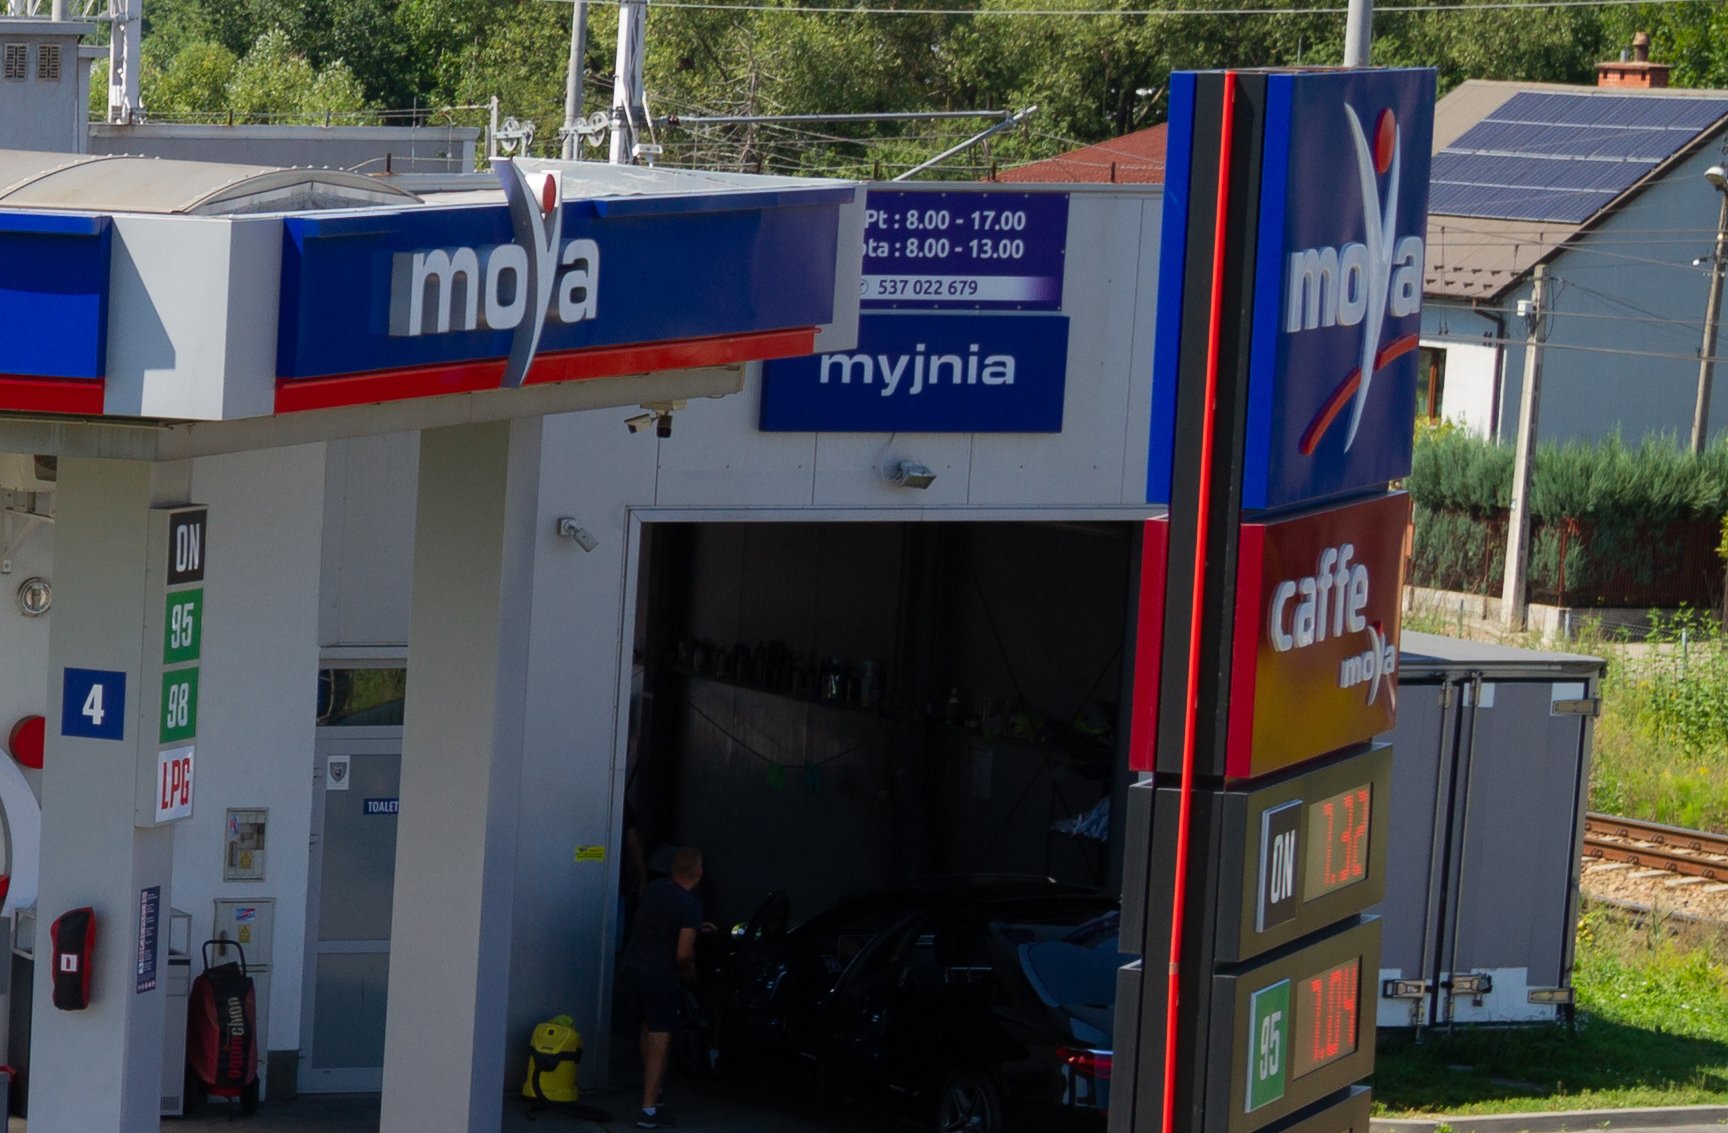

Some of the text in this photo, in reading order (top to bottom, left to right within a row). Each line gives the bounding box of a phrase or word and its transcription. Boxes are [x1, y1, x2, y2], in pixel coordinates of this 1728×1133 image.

[865, 210, 888, 229] Pt
[906, 210, 950, 230] 8.00
[971, 211, 1026, 231] 17.00
[906, 238, 949, 258] 8.00
[969, 239, 1024, 259] 13.00
[878, 279, 978, 296] 537 022 679
[820, 343, 1016, 397] myjnia
[175, 523, 201, 573] ON
[1271, 543, 1369, 652] caffe
[171, 602, 194, 649] 95
[82, 683, 105, 724] 4
[166, 682, 189, 729] 98
[160, 757, 191, 810] LPG
[1271, 829, 1296, 904] ON
[1260, 1010, 1282, 1080] 95
